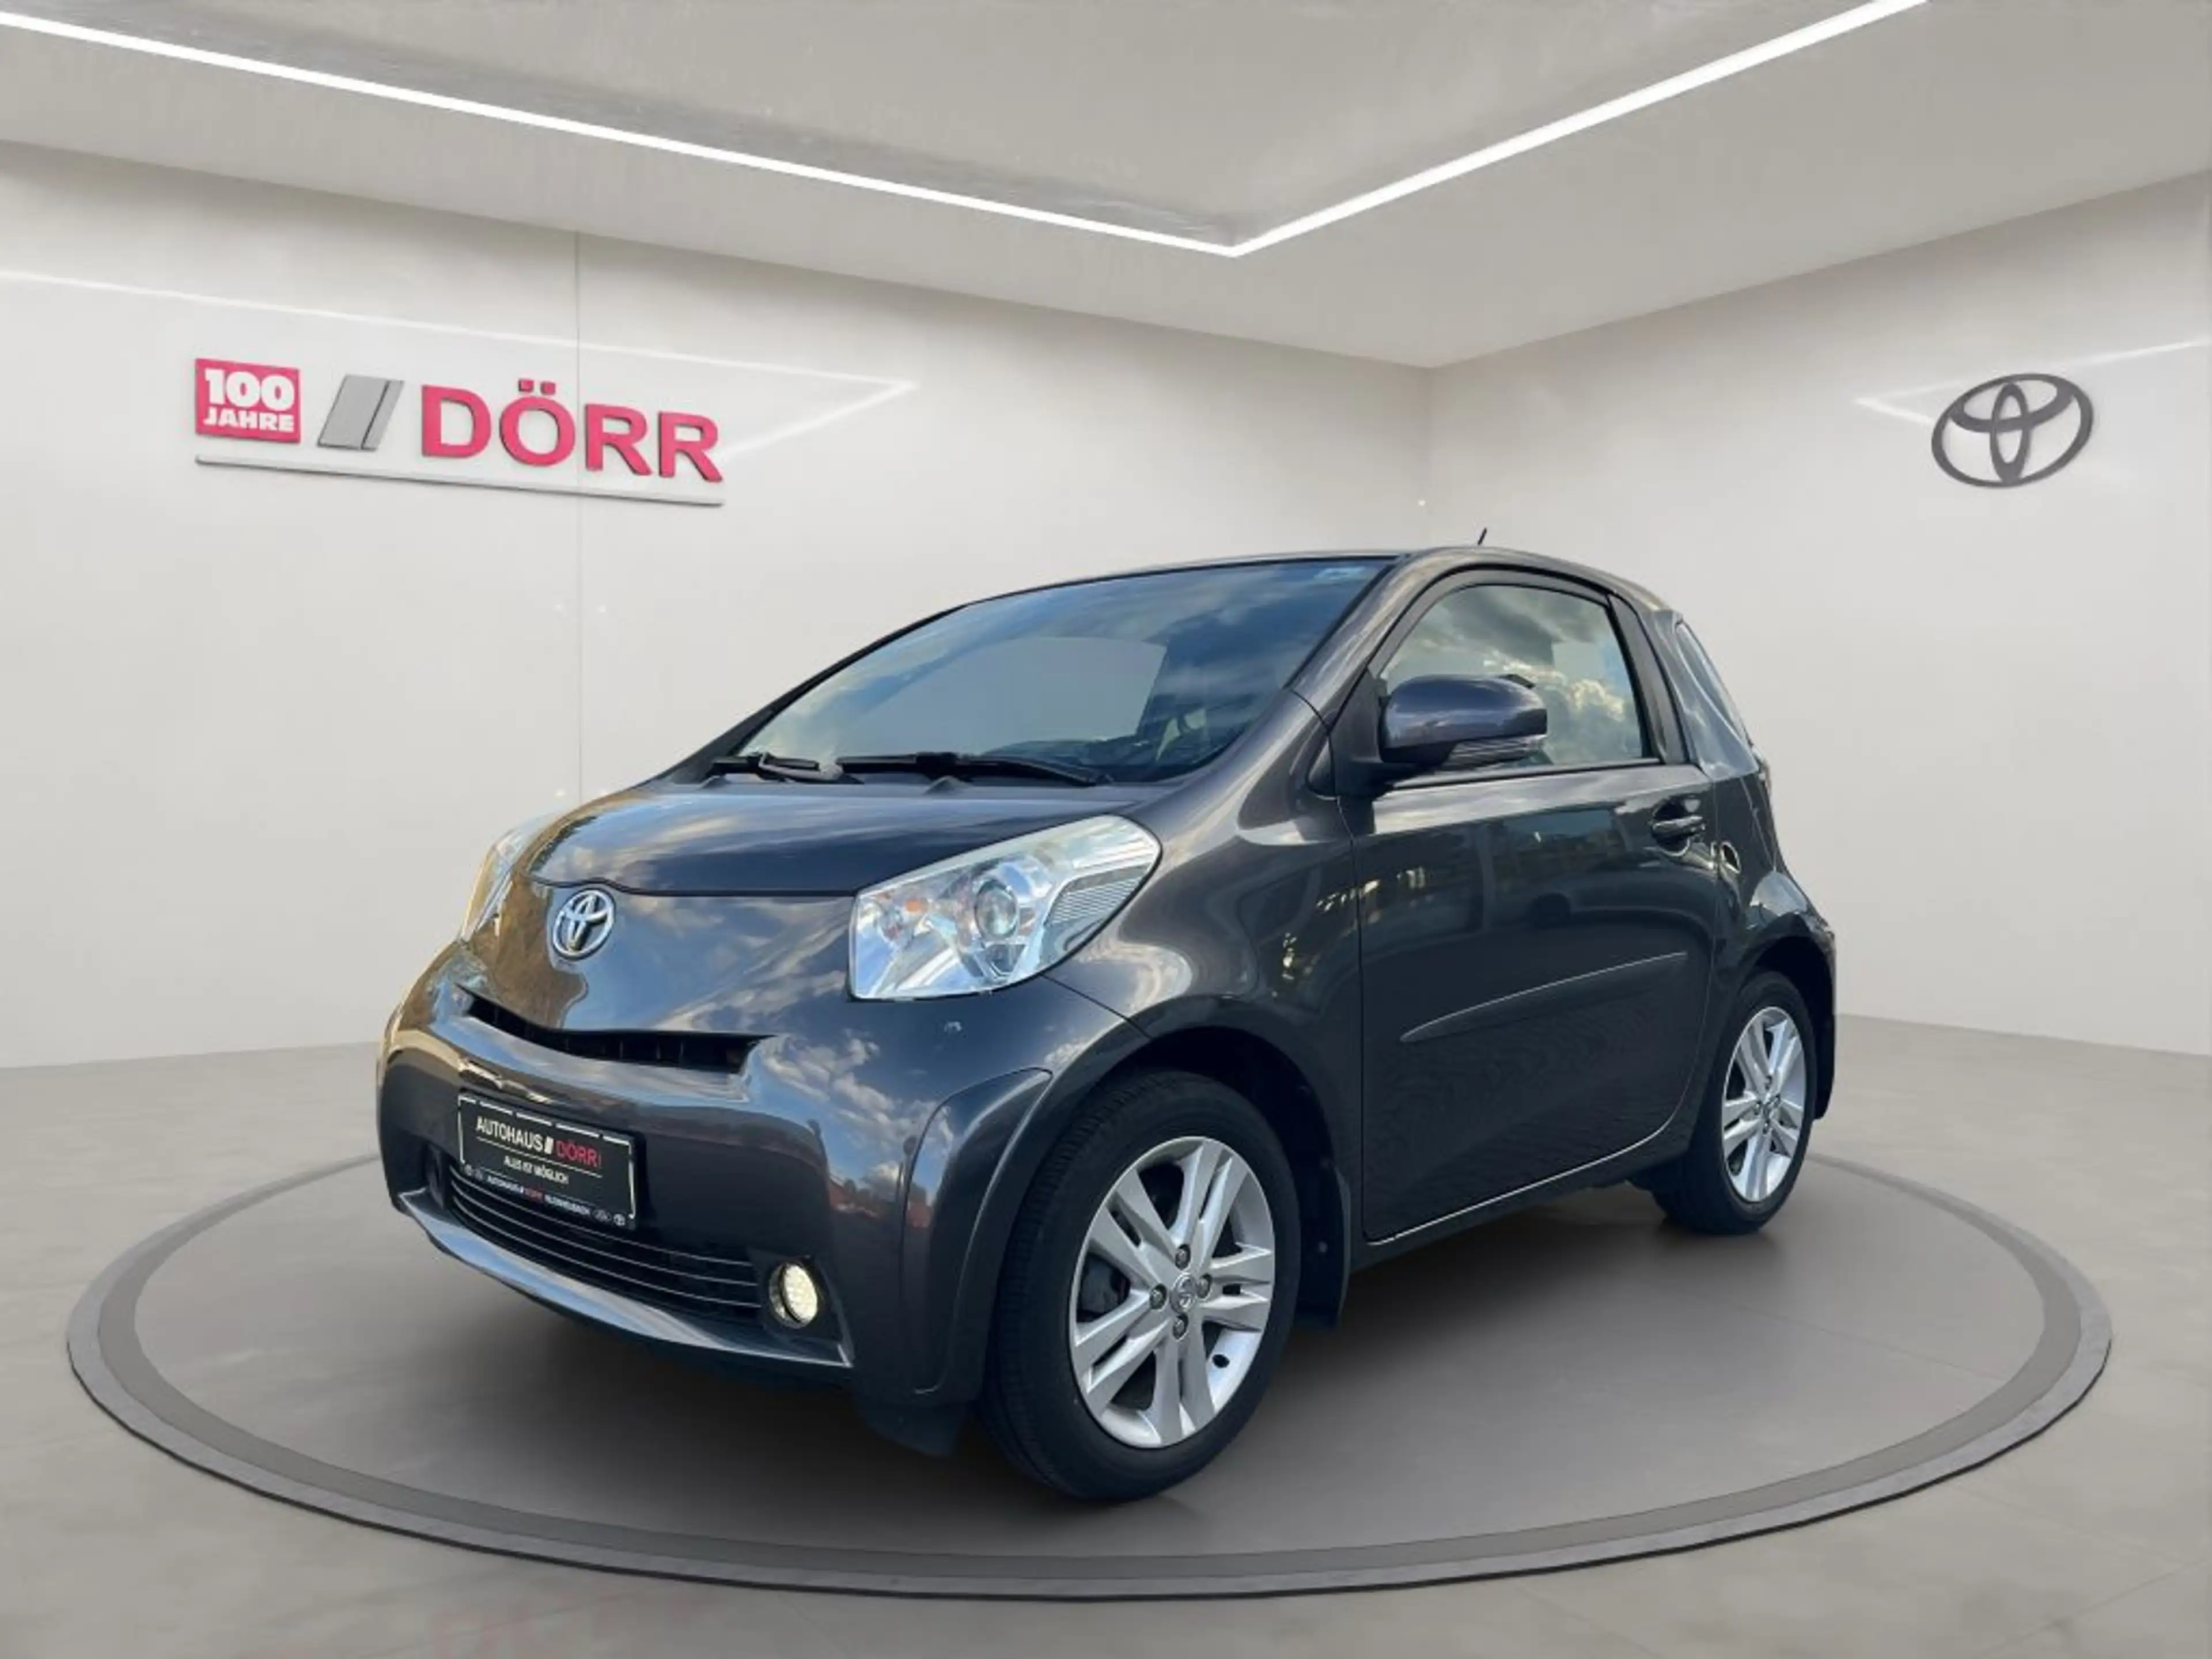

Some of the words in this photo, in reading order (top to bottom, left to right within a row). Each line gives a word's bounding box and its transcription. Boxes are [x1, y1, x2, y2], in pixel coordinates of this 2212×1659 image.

[204, 368, 296, 409] 100
[203, 407, 295, 433] JAHRE
[422, 378, 723, 482] DÖRR
[476, 1116, 543, 1151] AUTOHAUS
